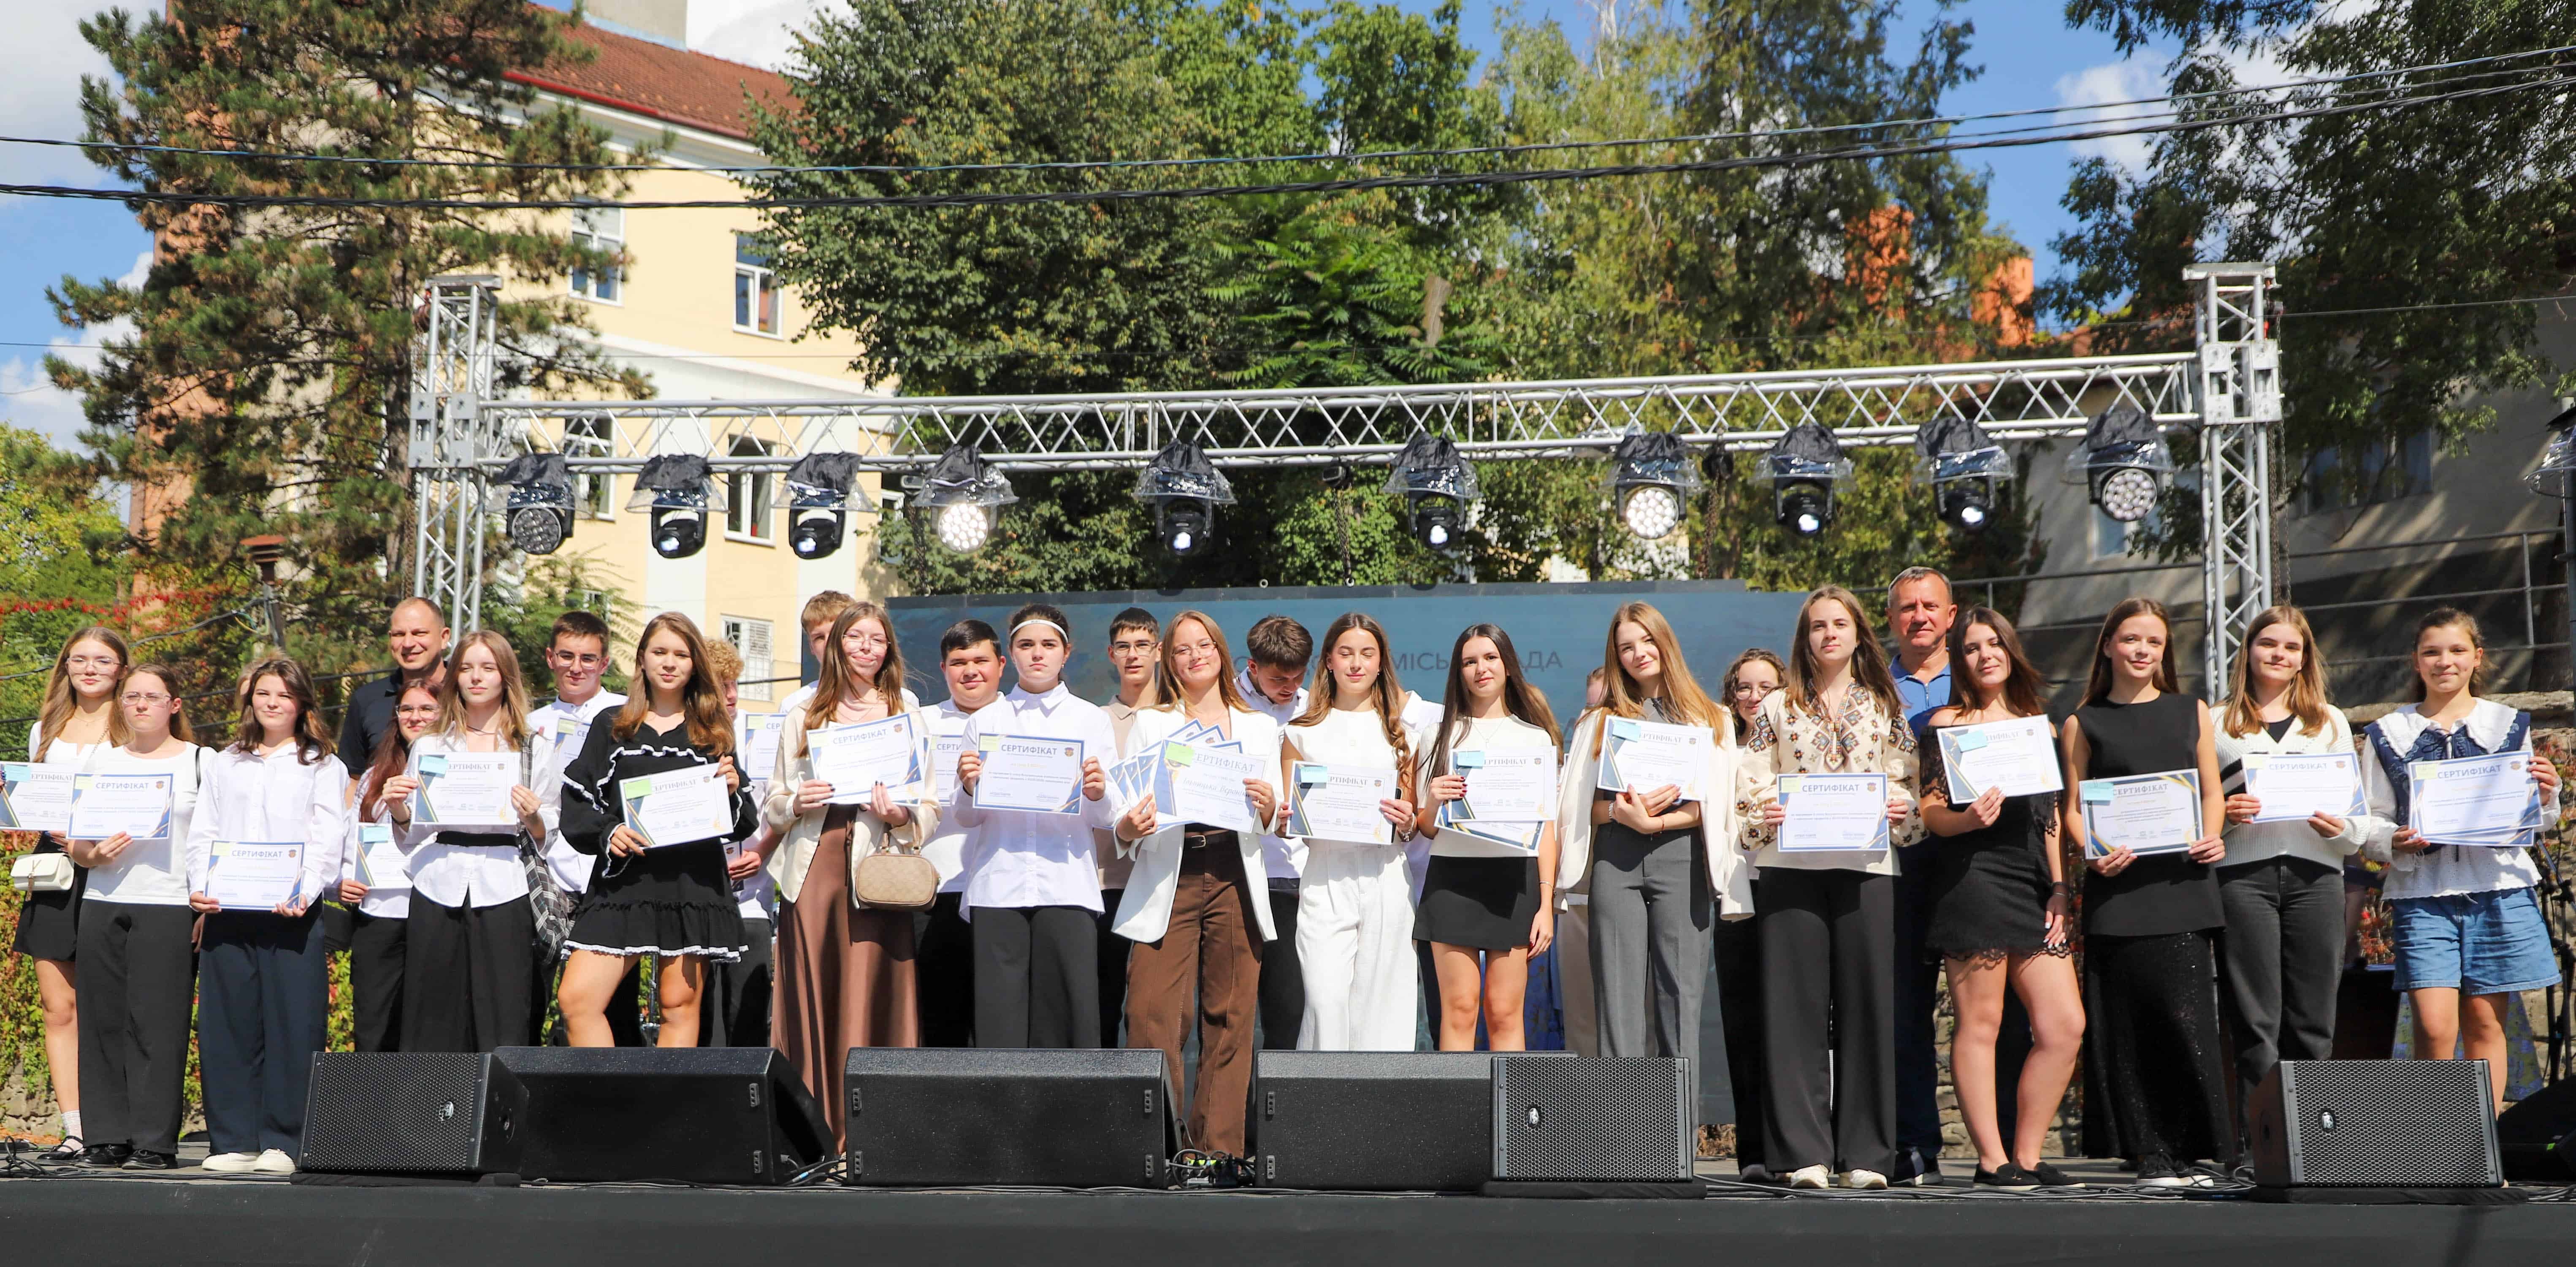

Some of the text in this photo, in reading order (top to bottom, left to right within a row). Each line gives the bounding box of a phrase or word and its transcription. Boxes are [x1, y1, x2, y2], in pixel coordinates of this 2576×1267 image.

[1392, 653, 1449, 670] МІСЬ
[833, 729, 887, 744] СЕРТИФІКАТ
[1639, 733, 1682, 743] ЕРТИФІКАТ
[1001, 744, 1057, 755] СЕРТИФІКАТ
[2438, 764, 2502, 779] СЕРТИФІКАТ
[31, 773, 73, 781] ЕРТИФІКАТ
[1330, 776, 1368, 785] РТИФІКАТ
[655, 779, 697, 791] ЕРТИФІКАТ
[1802, 784, 1860, 792] СЕРТИФІКАТ
[232, 850, 283, 858] СЕРТИФІКАТ
